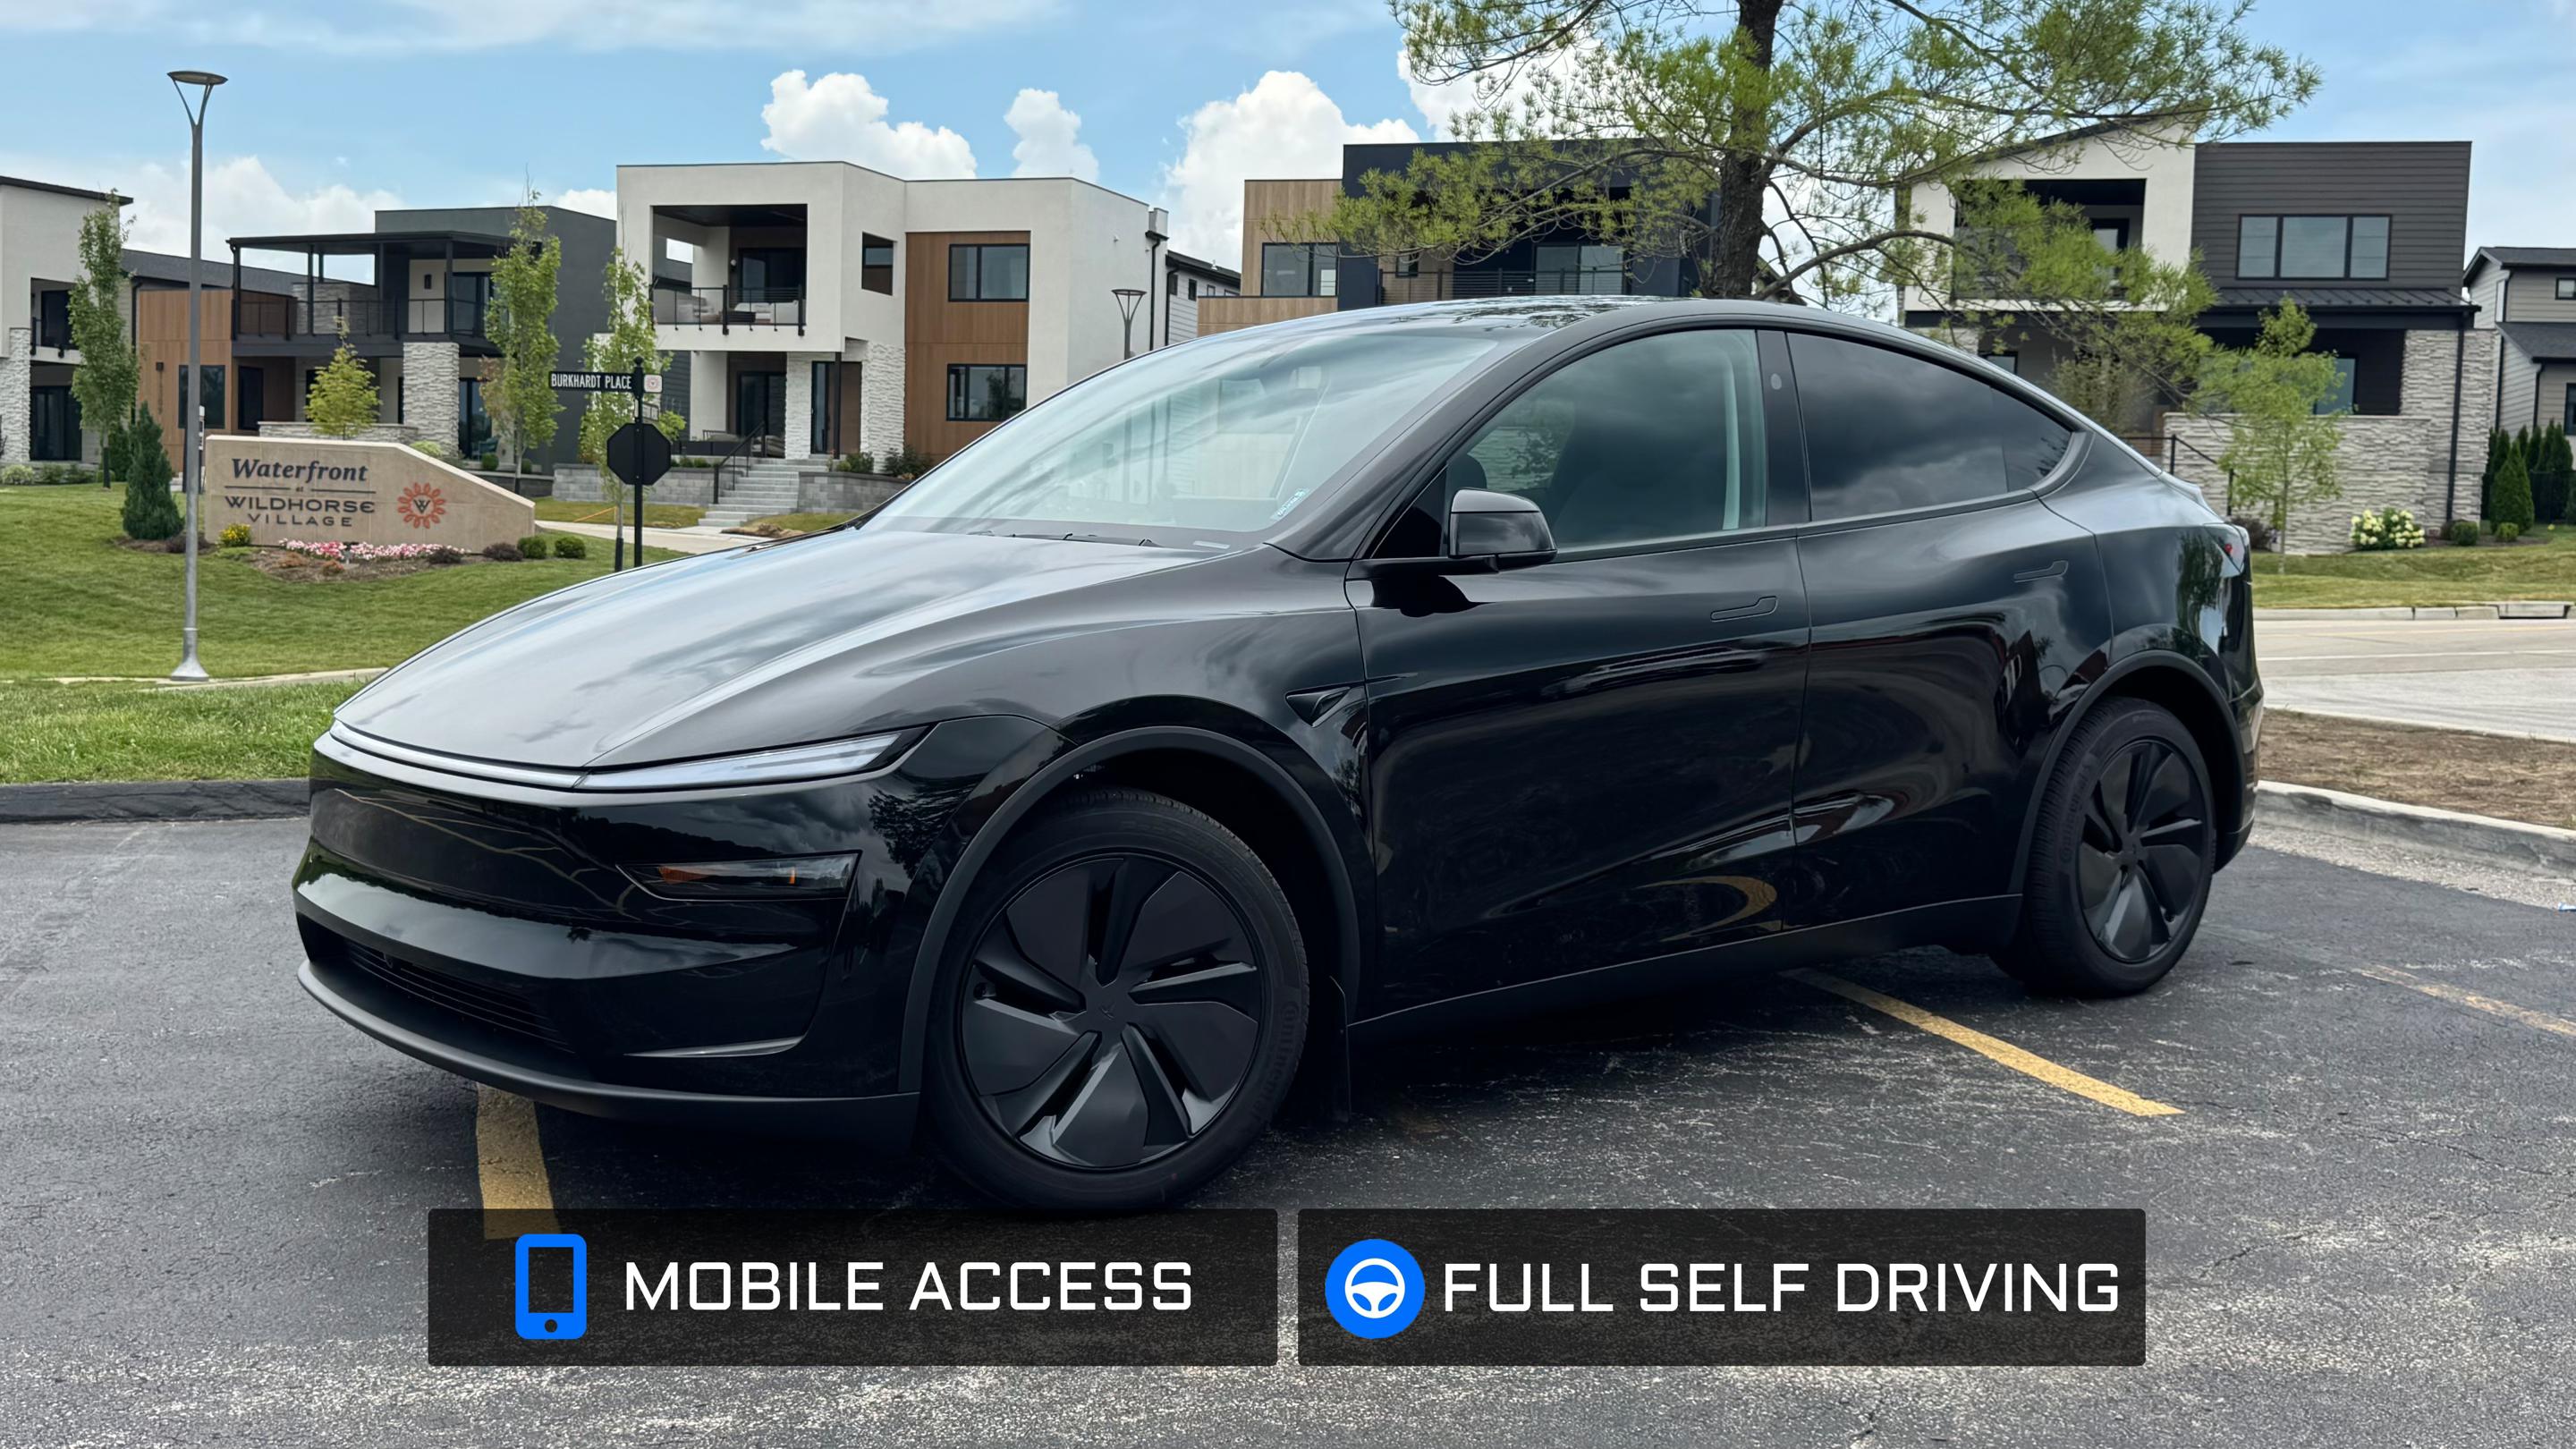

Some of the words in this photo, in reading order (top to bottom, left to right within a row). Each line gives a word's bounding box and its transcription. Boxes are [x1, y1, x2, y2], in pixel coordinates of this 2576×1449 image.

[551, 373, 601, 388] BURKHARDT
[605, 376, 632, 390] PLACE
[232, 458, 369, 484] Waterfront
[225, 496, 377, 514] WILDHORSE
[248, 513, 352, 528] VILLAGE
